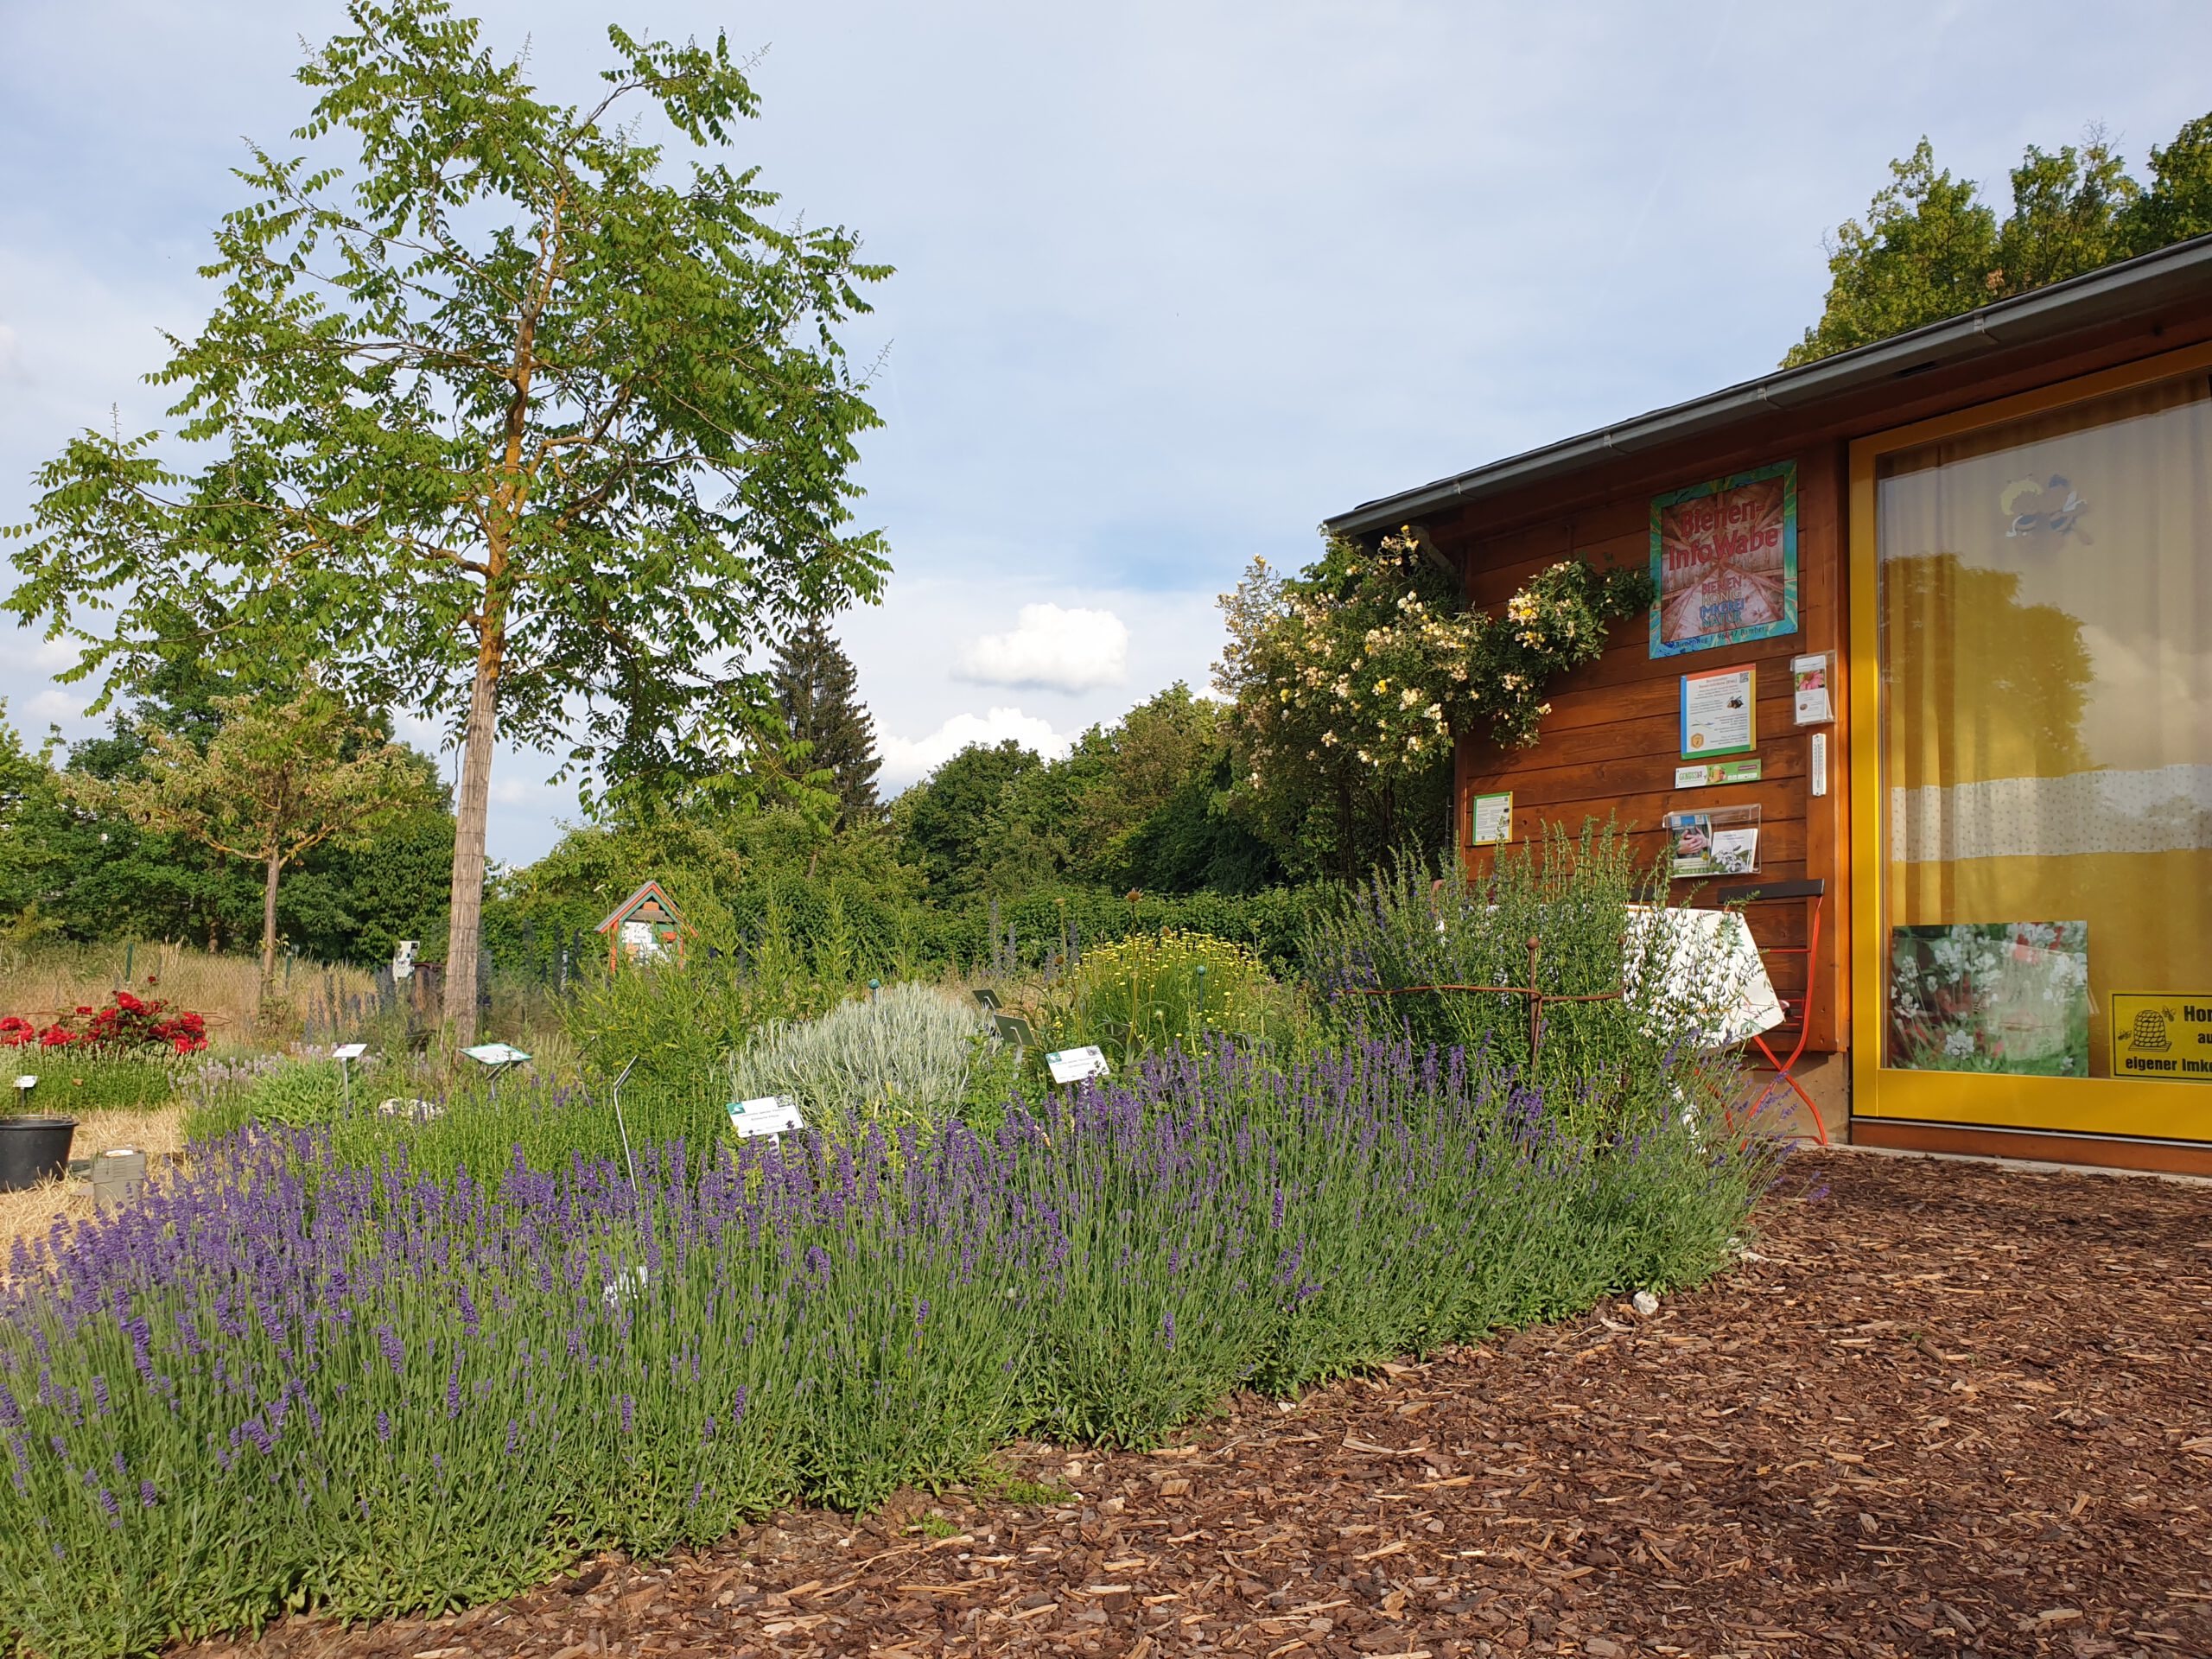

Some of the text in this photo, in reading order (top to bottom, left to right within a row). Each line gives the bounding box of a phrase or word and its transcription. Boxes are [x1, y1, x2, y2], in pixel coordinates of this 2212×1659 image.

[1681, 500, 1766, 538] Bienen-
[1701, 575, 1742, 594] BIENEN
[1702, 588, 1742, 606] HONIG
[1700, 599, 1744, 619] IMKEREI
[1702, 610, 1742, 627] NATUR
[1717, 630, 1738, 639] 9647
[2198, 1033, 2212, 1044] au
[2126, 1057, 2177, 1071] eigener
